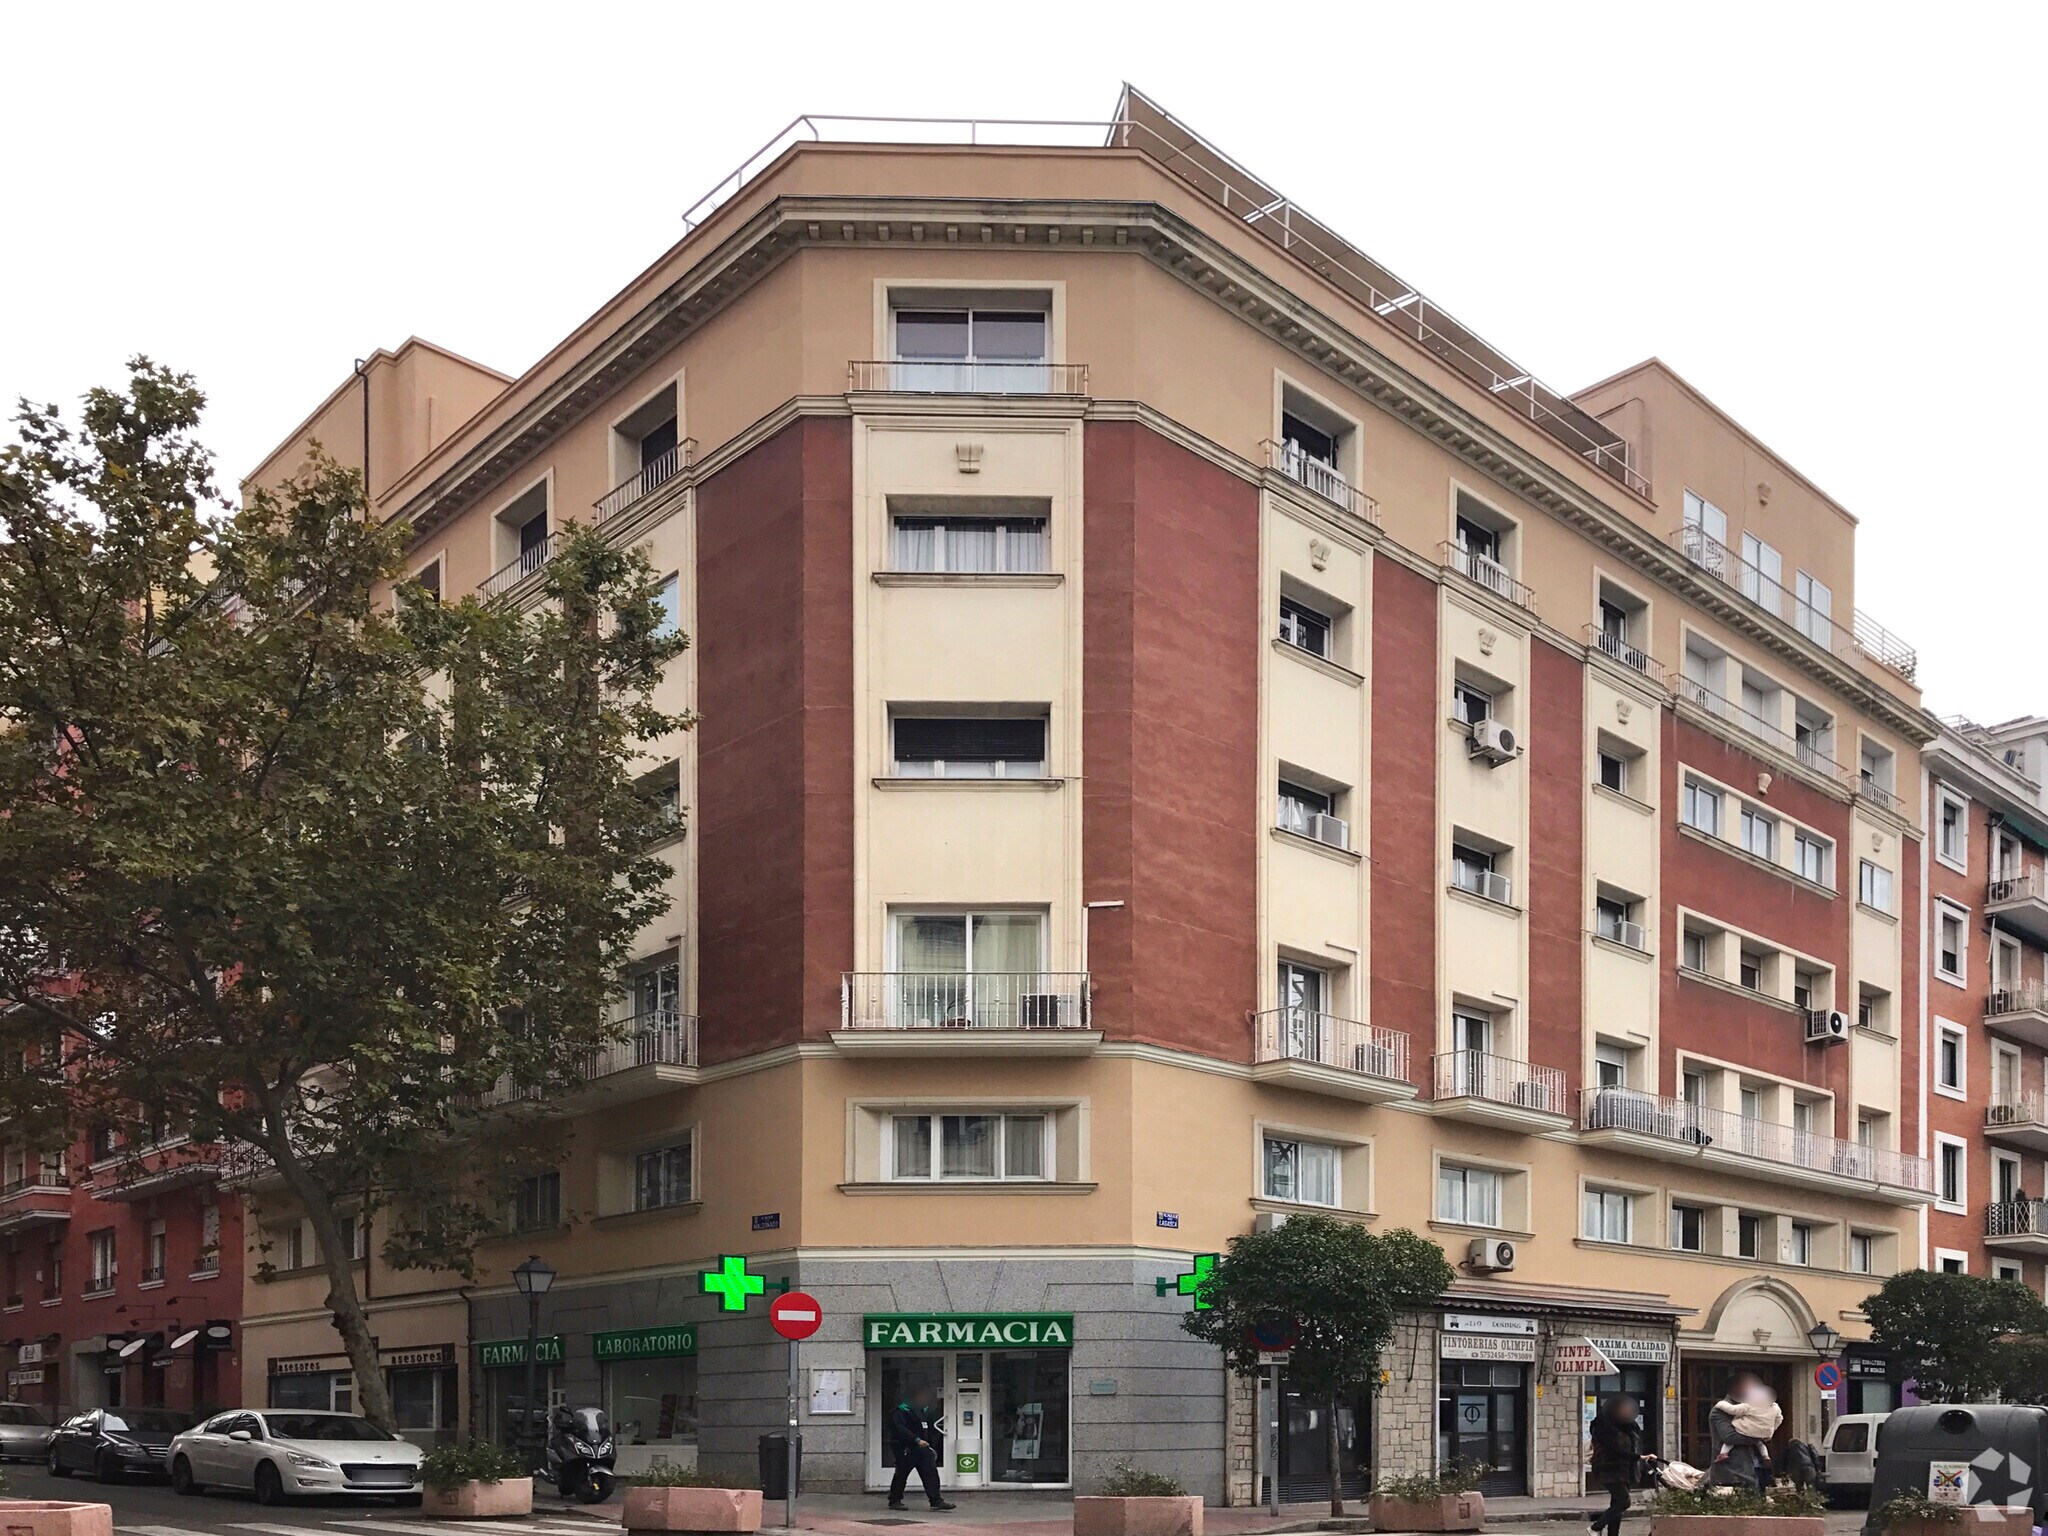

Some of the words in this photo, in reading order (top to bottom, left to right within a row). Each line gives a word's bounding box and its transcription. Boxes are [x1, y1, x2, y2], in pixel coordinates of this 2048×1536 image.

[869, 1321, 1067, 1343] FARMACIA
[597, 1333, 692, 1355] LABORATORIO
[1442, 1336, 1498, 1350] TINTORERIAS
[1501, 1339, 1534, 1352] OLIMPIA
[1631, 1340, 1666, 1351] CALIDAD
[391, 1351, 442, 1365] asesores
[1556, 1345, 1592, 1358] TINTE
[278, 1361, 321, 1373] asesores
[1554, 1360, 1607, 1373] OLIMPIA
